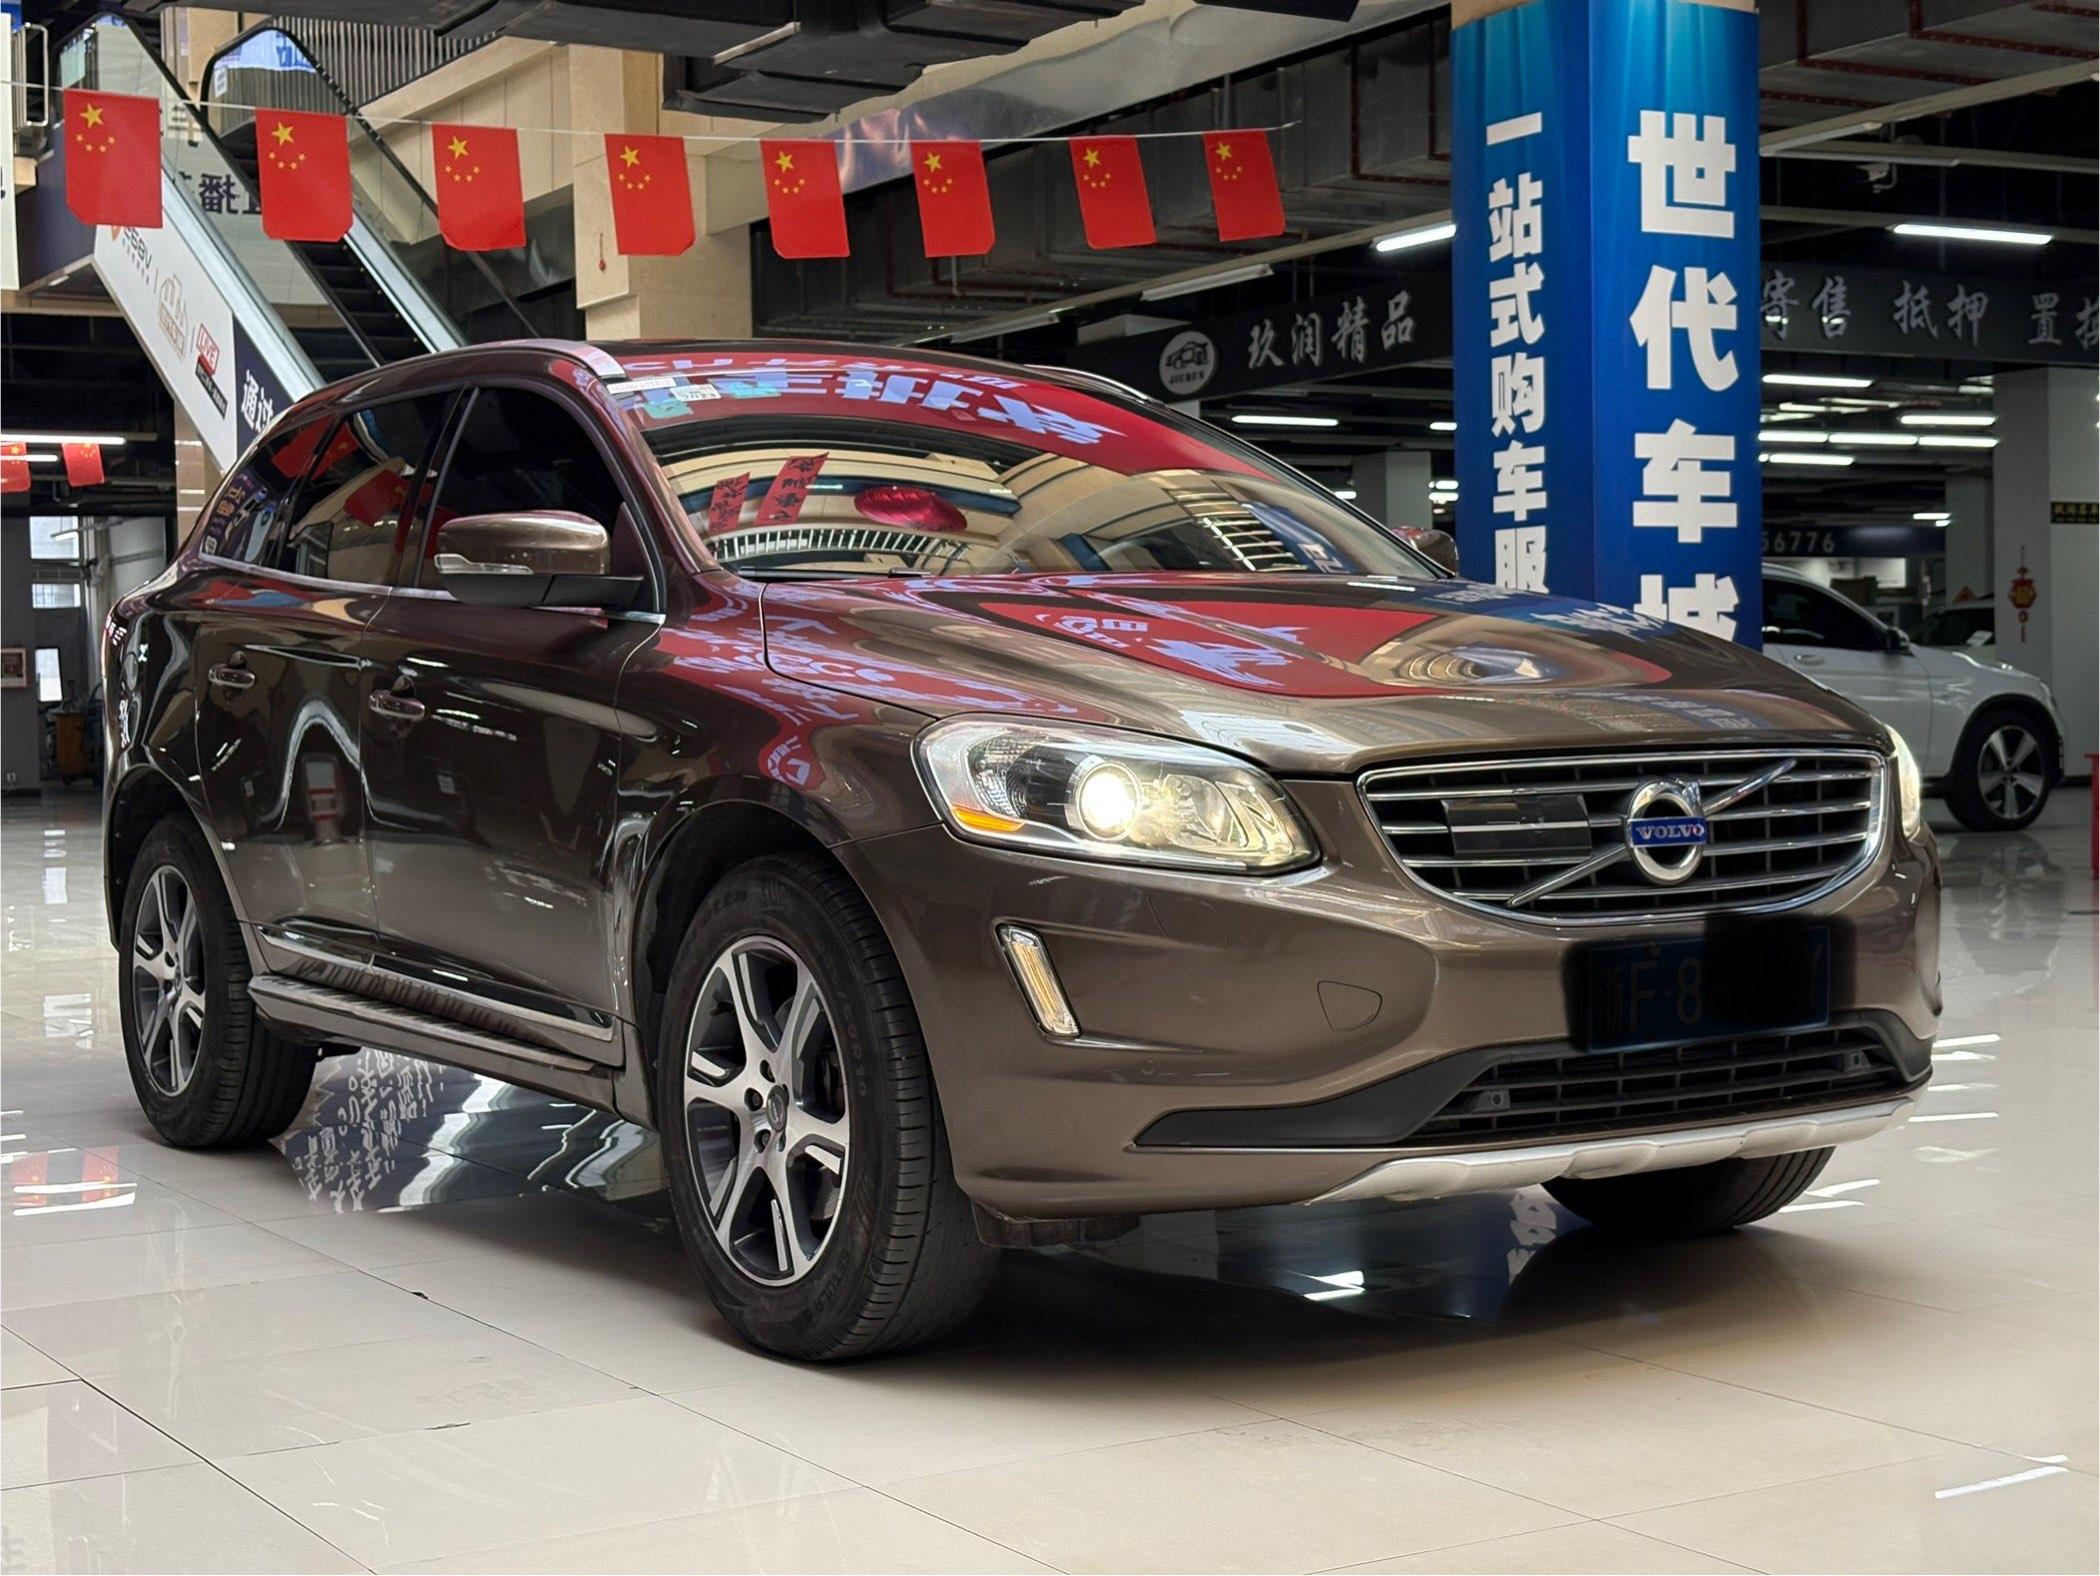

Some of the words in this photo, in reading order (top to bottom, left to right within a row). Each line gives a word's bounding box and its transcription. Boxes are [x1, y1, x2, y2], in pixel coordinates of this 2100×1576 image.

[1249, 290, 1414, 369] 玖润精品
[1893, 280, 1989, 347] 抵押
[1486, 112, 1549, 593] 一站式购车服
[1636, 823, 1705, 840] VOLVO
